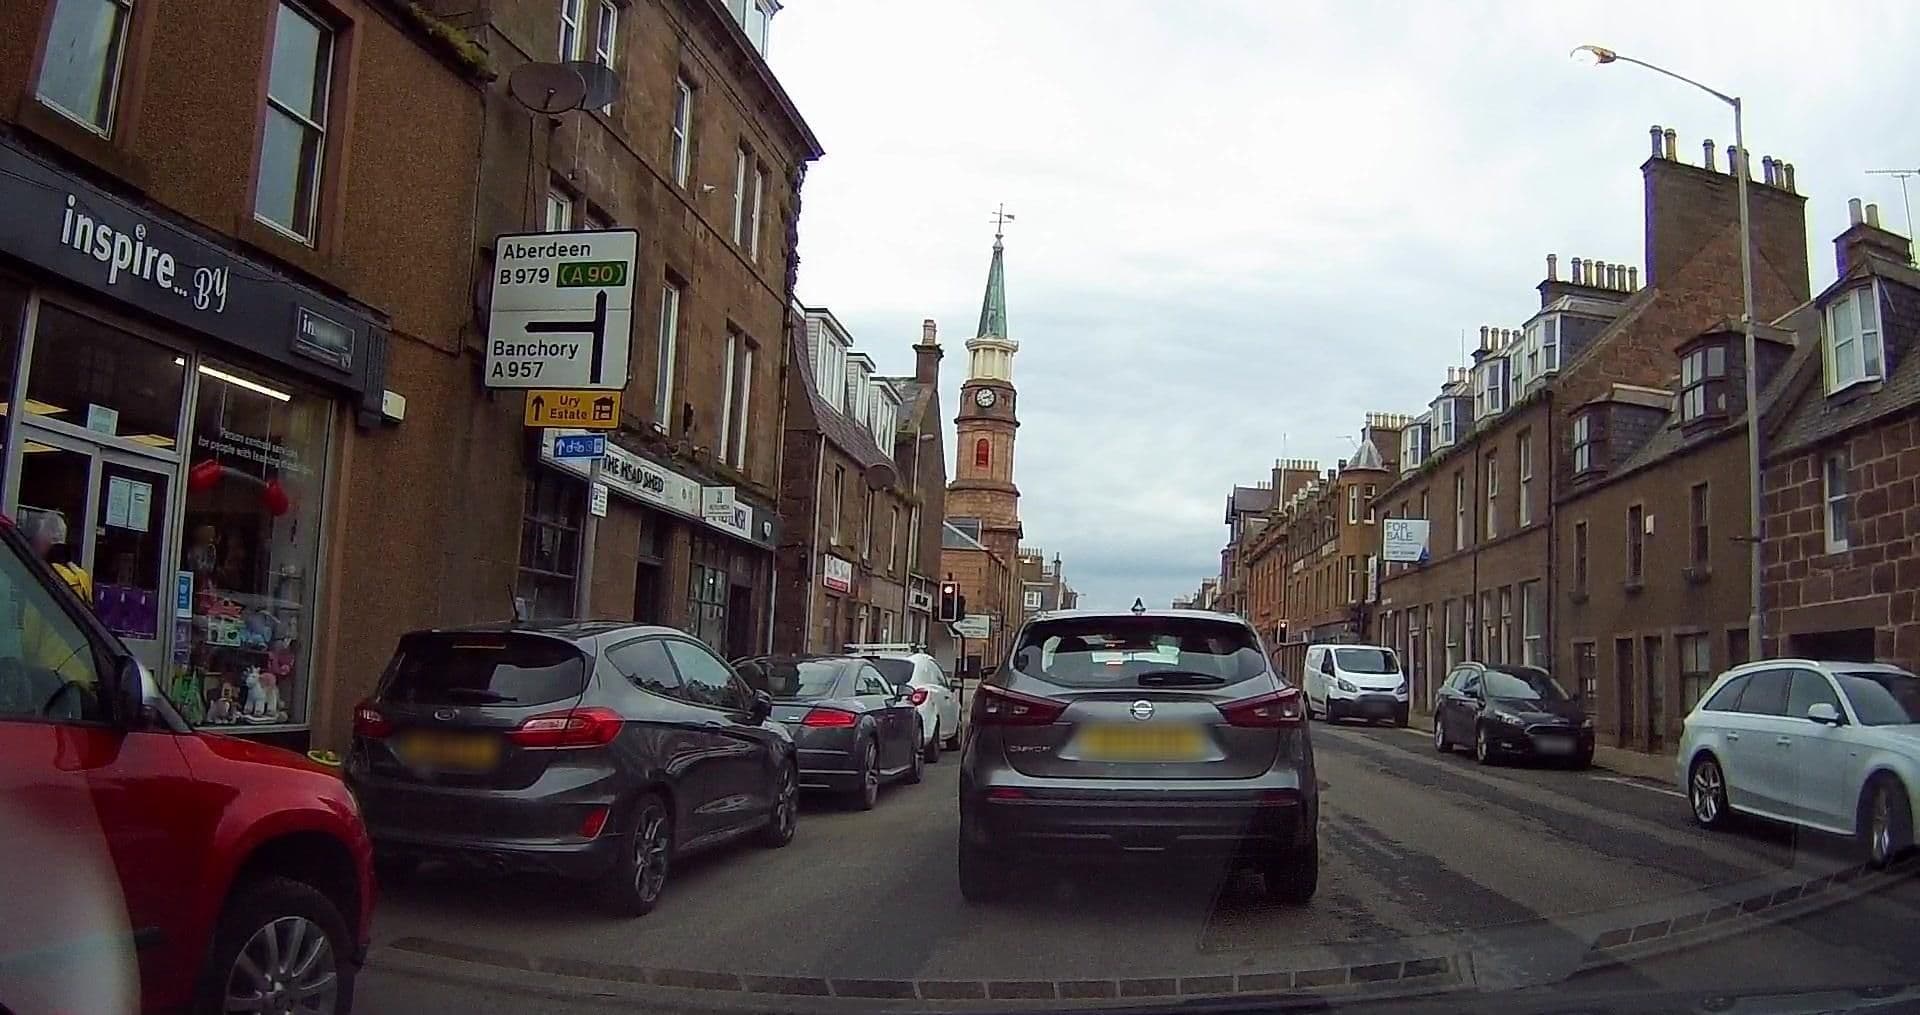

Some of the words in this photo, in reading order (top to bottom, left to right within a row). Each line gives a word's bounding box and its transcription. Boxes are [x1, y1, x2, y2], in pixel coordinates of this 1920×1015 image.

[503, 242, 591, 259] Aberdeen
[493, 340, 579, 359] Banchory
[560, 395, 581, 407] Ury
[550, 408, 588, 419] Estate
[602, 453, 620, 475] THE
[642, 471, 664, 493] SHED
[1386, 522, 1408, 531] FOR
[1386, 532, 1413, 541] SALE
